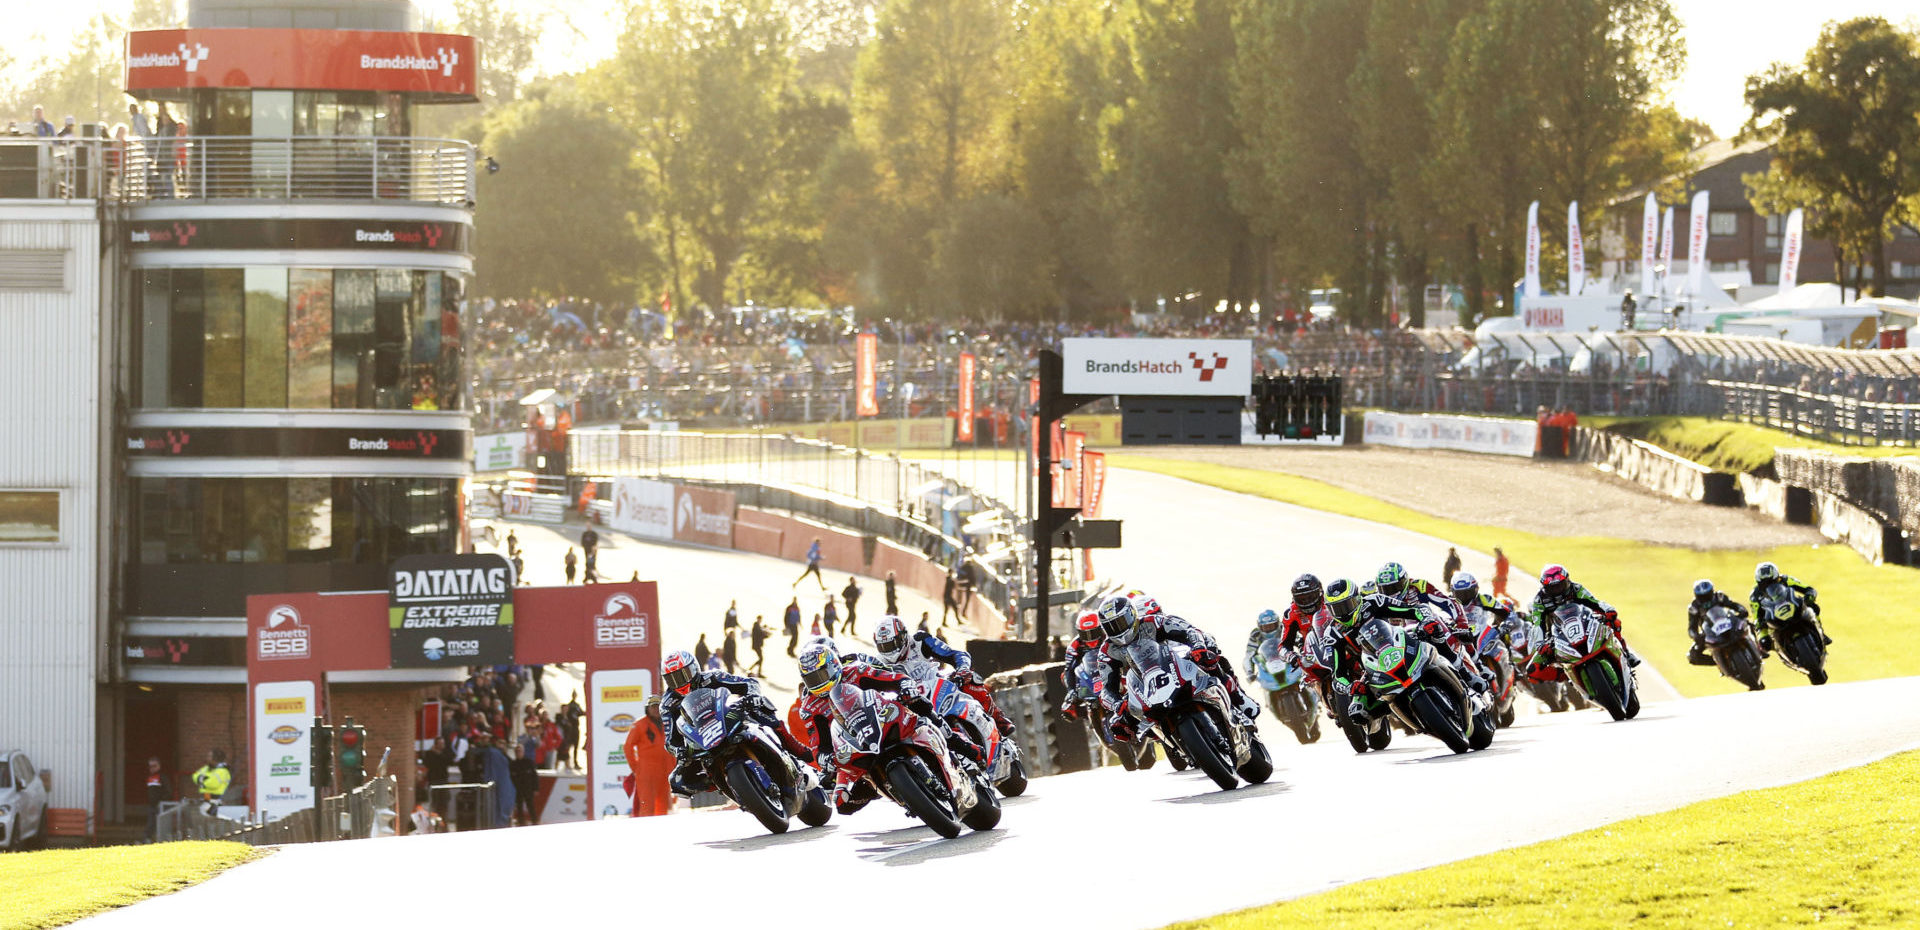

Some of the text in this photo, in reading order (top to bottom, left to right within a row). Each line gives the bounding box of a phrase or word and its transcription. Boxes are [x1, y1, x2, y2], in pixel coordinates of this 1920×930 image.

[361, 54, 438, 69] BrandsHatch
[356, 229, 422, 242] BrandsHatch
[1086, 360, 1183, 374] BrandsHatch
[349, 438, 416, 451] BrandsHatch
[395, 567, 505, 597] DATATAG
[406, 604, 500, 618] EXTREME
[403, 616, 497, 629] QUALIFYING
[597, 617, 645, 627] Bennetts
[260, 629, 308, 639] Bennetts
[597, 626, 646, 641] BSB
[260, 638, 308, 654] BSB
[701, 721, 723, 747] 22
[856, 724, 874, 746] 25
